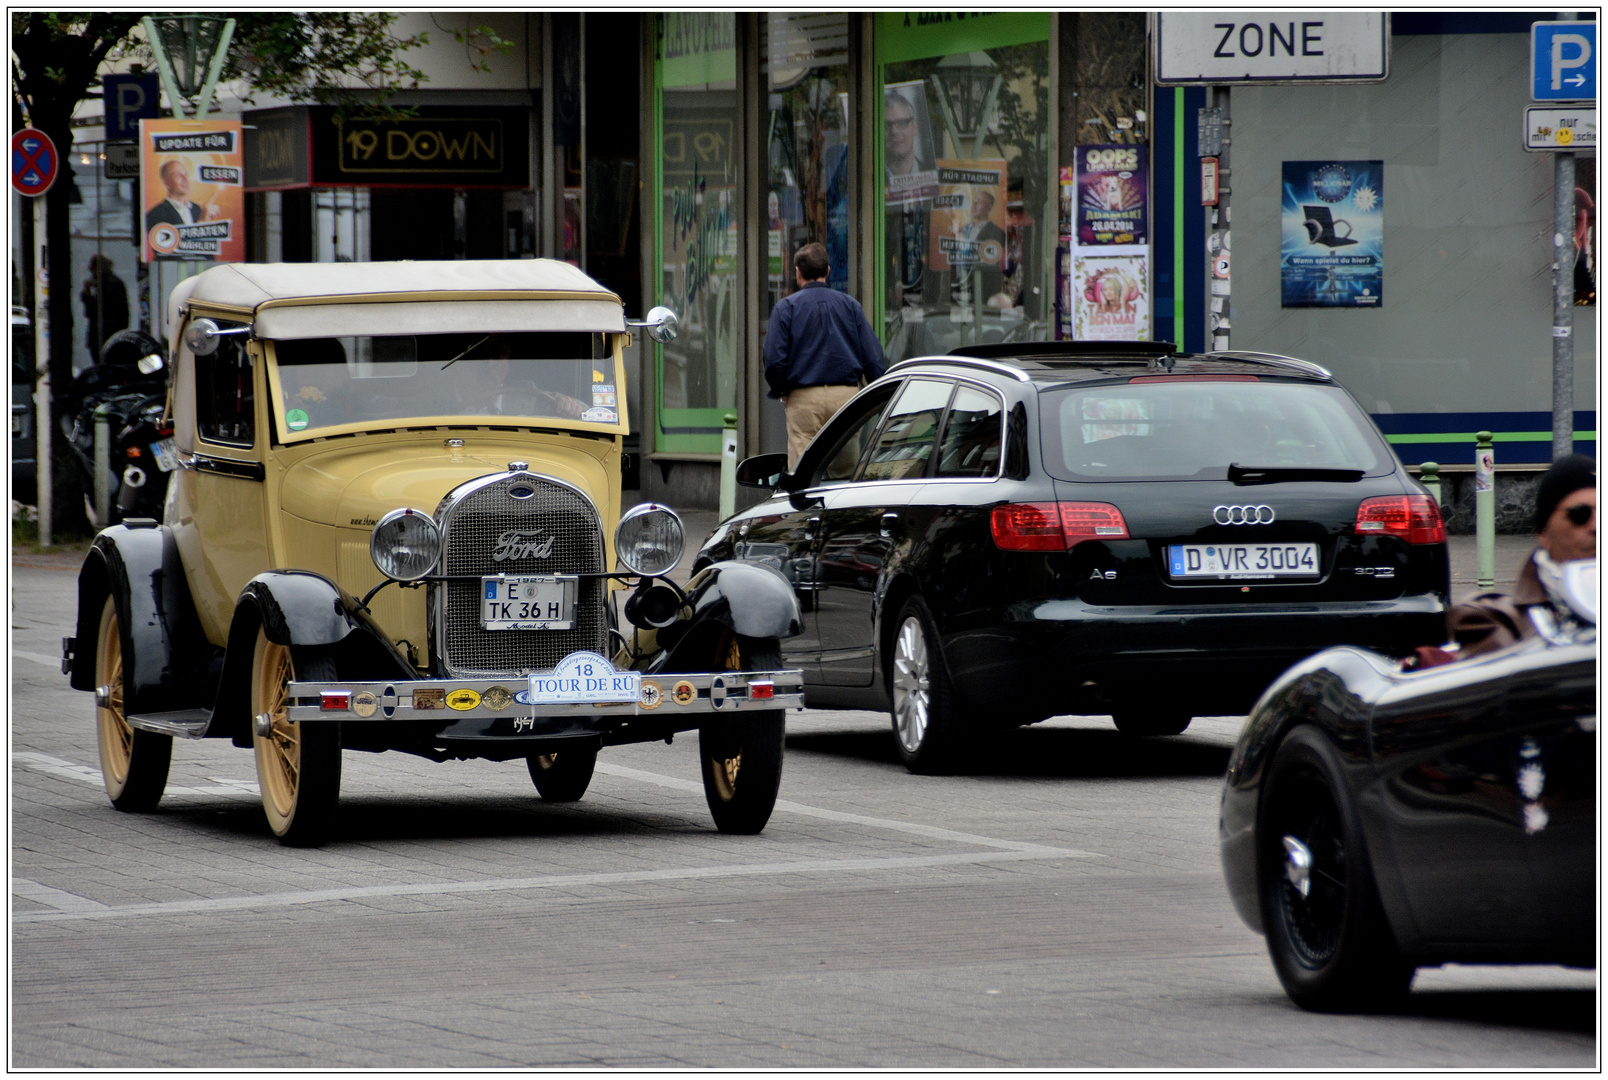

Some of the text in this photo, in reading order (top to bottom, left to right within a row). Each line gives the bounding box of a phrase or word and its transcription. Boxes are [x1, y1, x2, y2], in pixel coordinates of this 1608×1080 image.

[1213, 21, 1324, 58] ZONE
[1551, 33, 1592, 90] P
[116, 82, 146, 131] P
[1559, 118, 1579, 128] nur
[160, 135, 227, 150] UPDATE FÜR
[346, 130, 495, 160] 19 DOWN
[1085, 148, 1139, 164] OOPS
[203, 168, 238, 179] ESSEN
[180, 225, 227, 238] PIRATEN
[1293, 256, 1371, 266] Wann spielst du hier?
[1113, 314, 1135, 325] MAI
[492, 528, 556, 562] Ford
[1175, 562, 1181, 570] D
[1186, 546, 1313, 571] D VR 3004
[1089, 568, 1117, 580] A6
[487, 591, 494, 599] D
[508, 583, 519, 600] E
[489, 602, 559, 619] TK 36 H
[506, 622, 537, 630] Model
[574, 663, 594, 677] 18
[535, 675, 635, 693] TOUR DE RÜ
